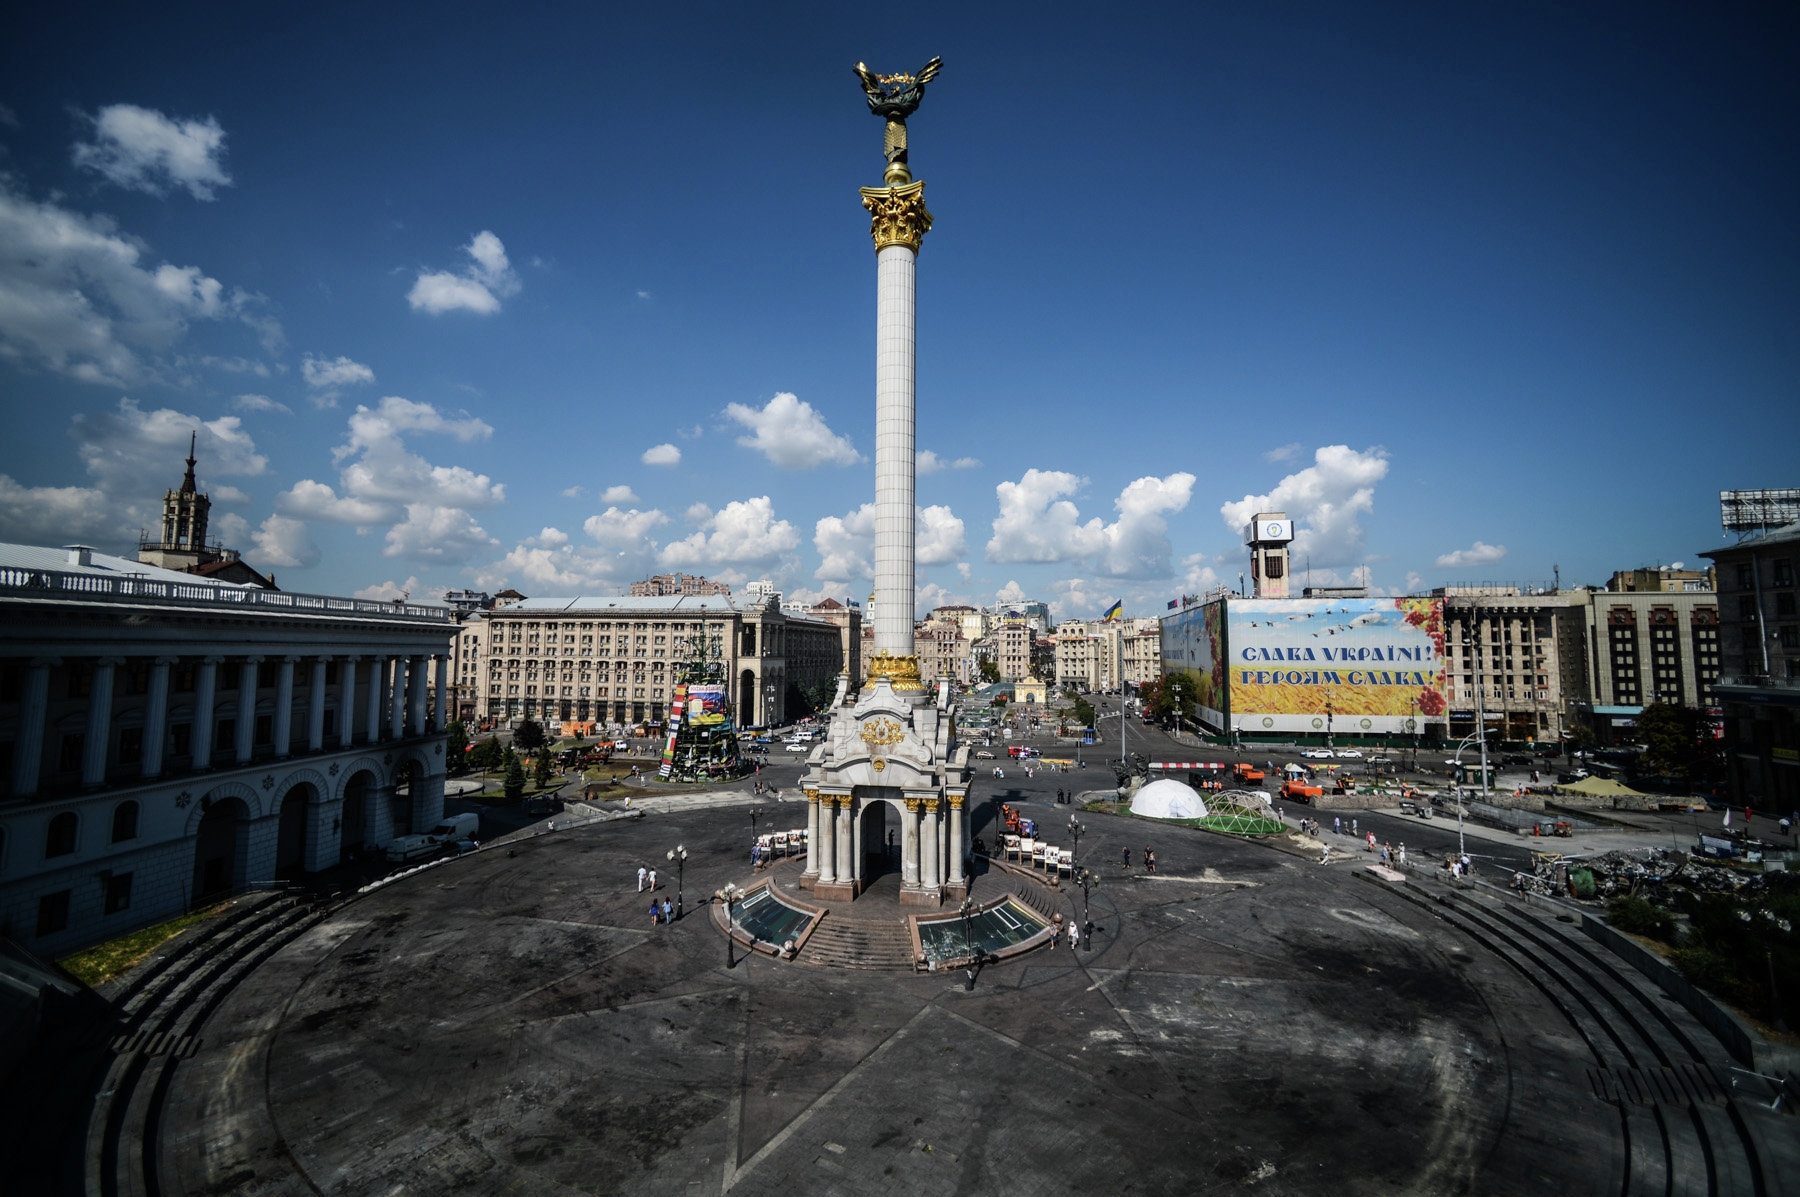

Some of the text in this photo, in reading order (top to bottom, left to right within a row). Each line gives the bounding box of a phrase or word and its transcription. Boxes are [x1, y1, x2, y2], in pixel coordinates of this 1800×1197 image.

[1242, 645, 1432, 662] СЛАВА УКРАЇНІ!
[1241, 670, 1433, 685] ГЕРОЯМ СЛАВА!
